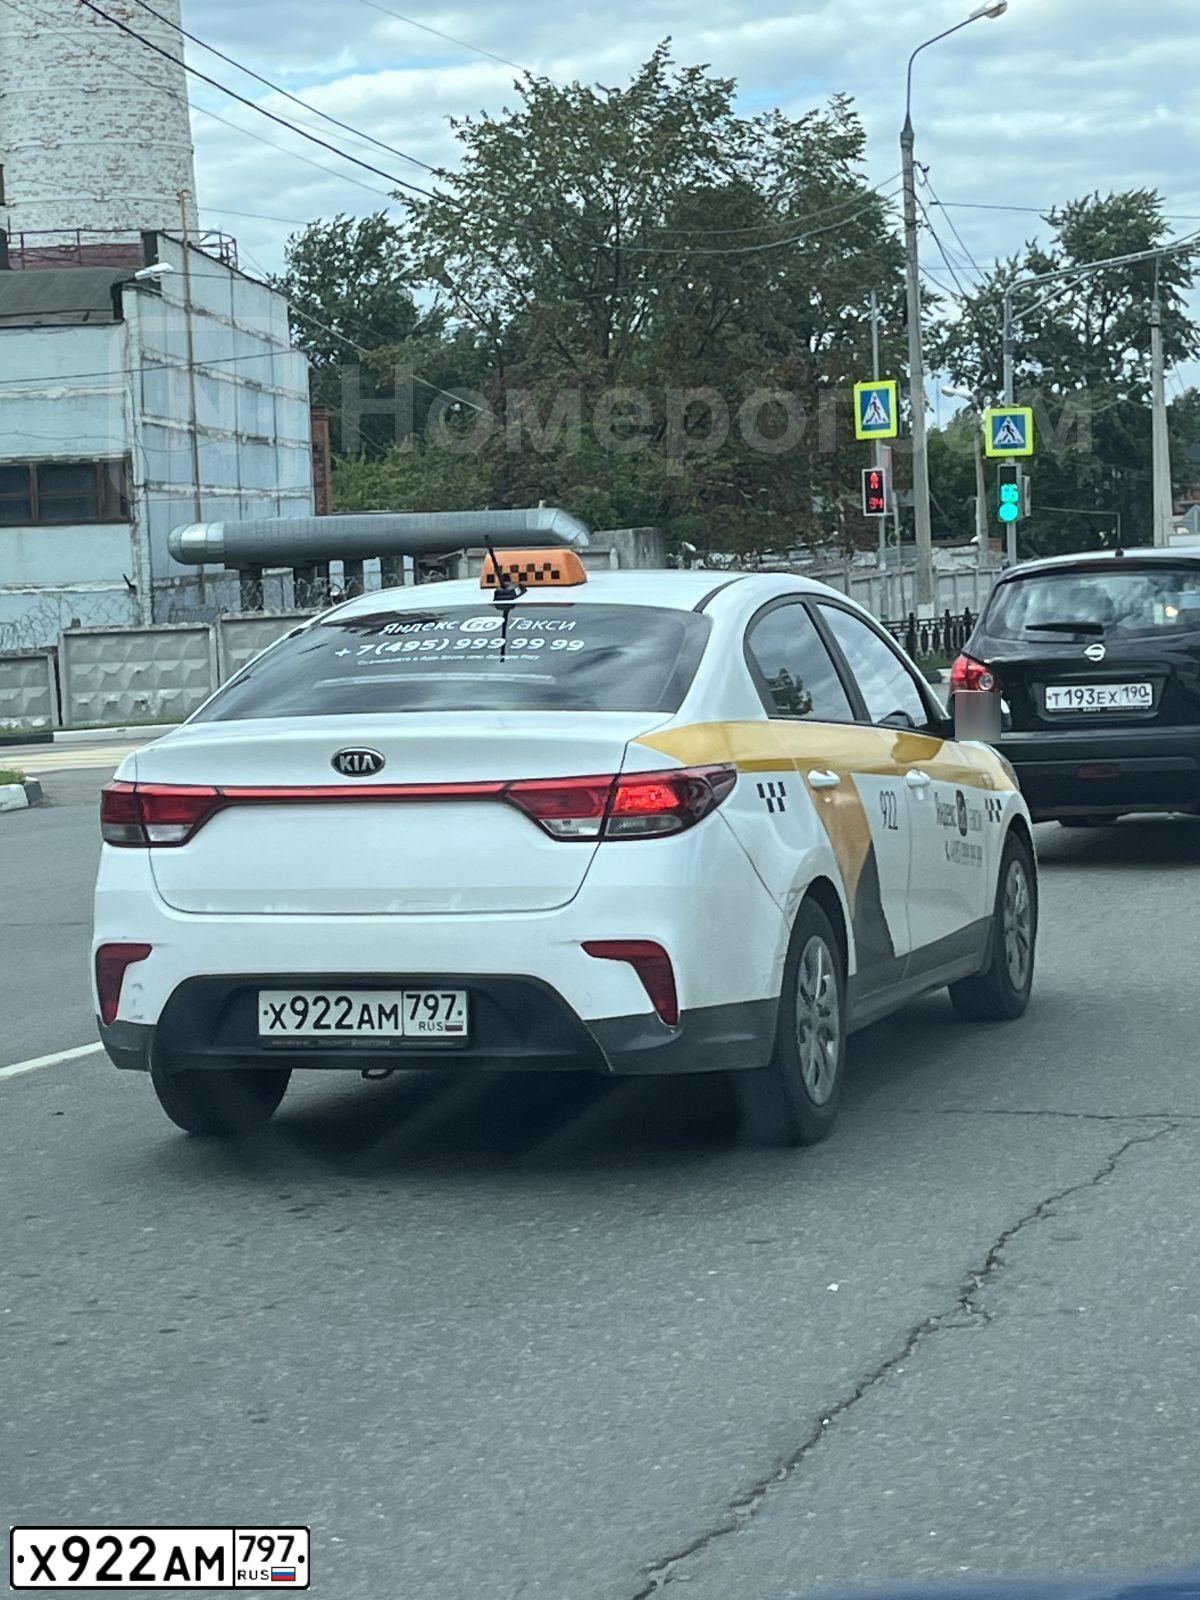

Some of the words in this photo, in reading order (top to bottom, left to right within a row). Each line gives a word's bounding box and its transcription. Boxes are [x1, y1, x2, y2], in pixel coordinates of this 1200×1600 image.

[379, 620, 459, 635] Яндекс
[508, 617, 577, 631] Такси
[453, 637, 507, 650] 999
[510, 638, 546, 650] 99
[550, 639, 585, 651] 99
[1052, 688, 1118, 706] Т193ЕХ
[1122, 685, 1148, 699] 190
[340, 754, 376, 771] KIA
[268, 995, 399, 1031] Х922АМ
[405, 993, 458, 1021] 797
[418, 1021, 444, 1032] RUS
